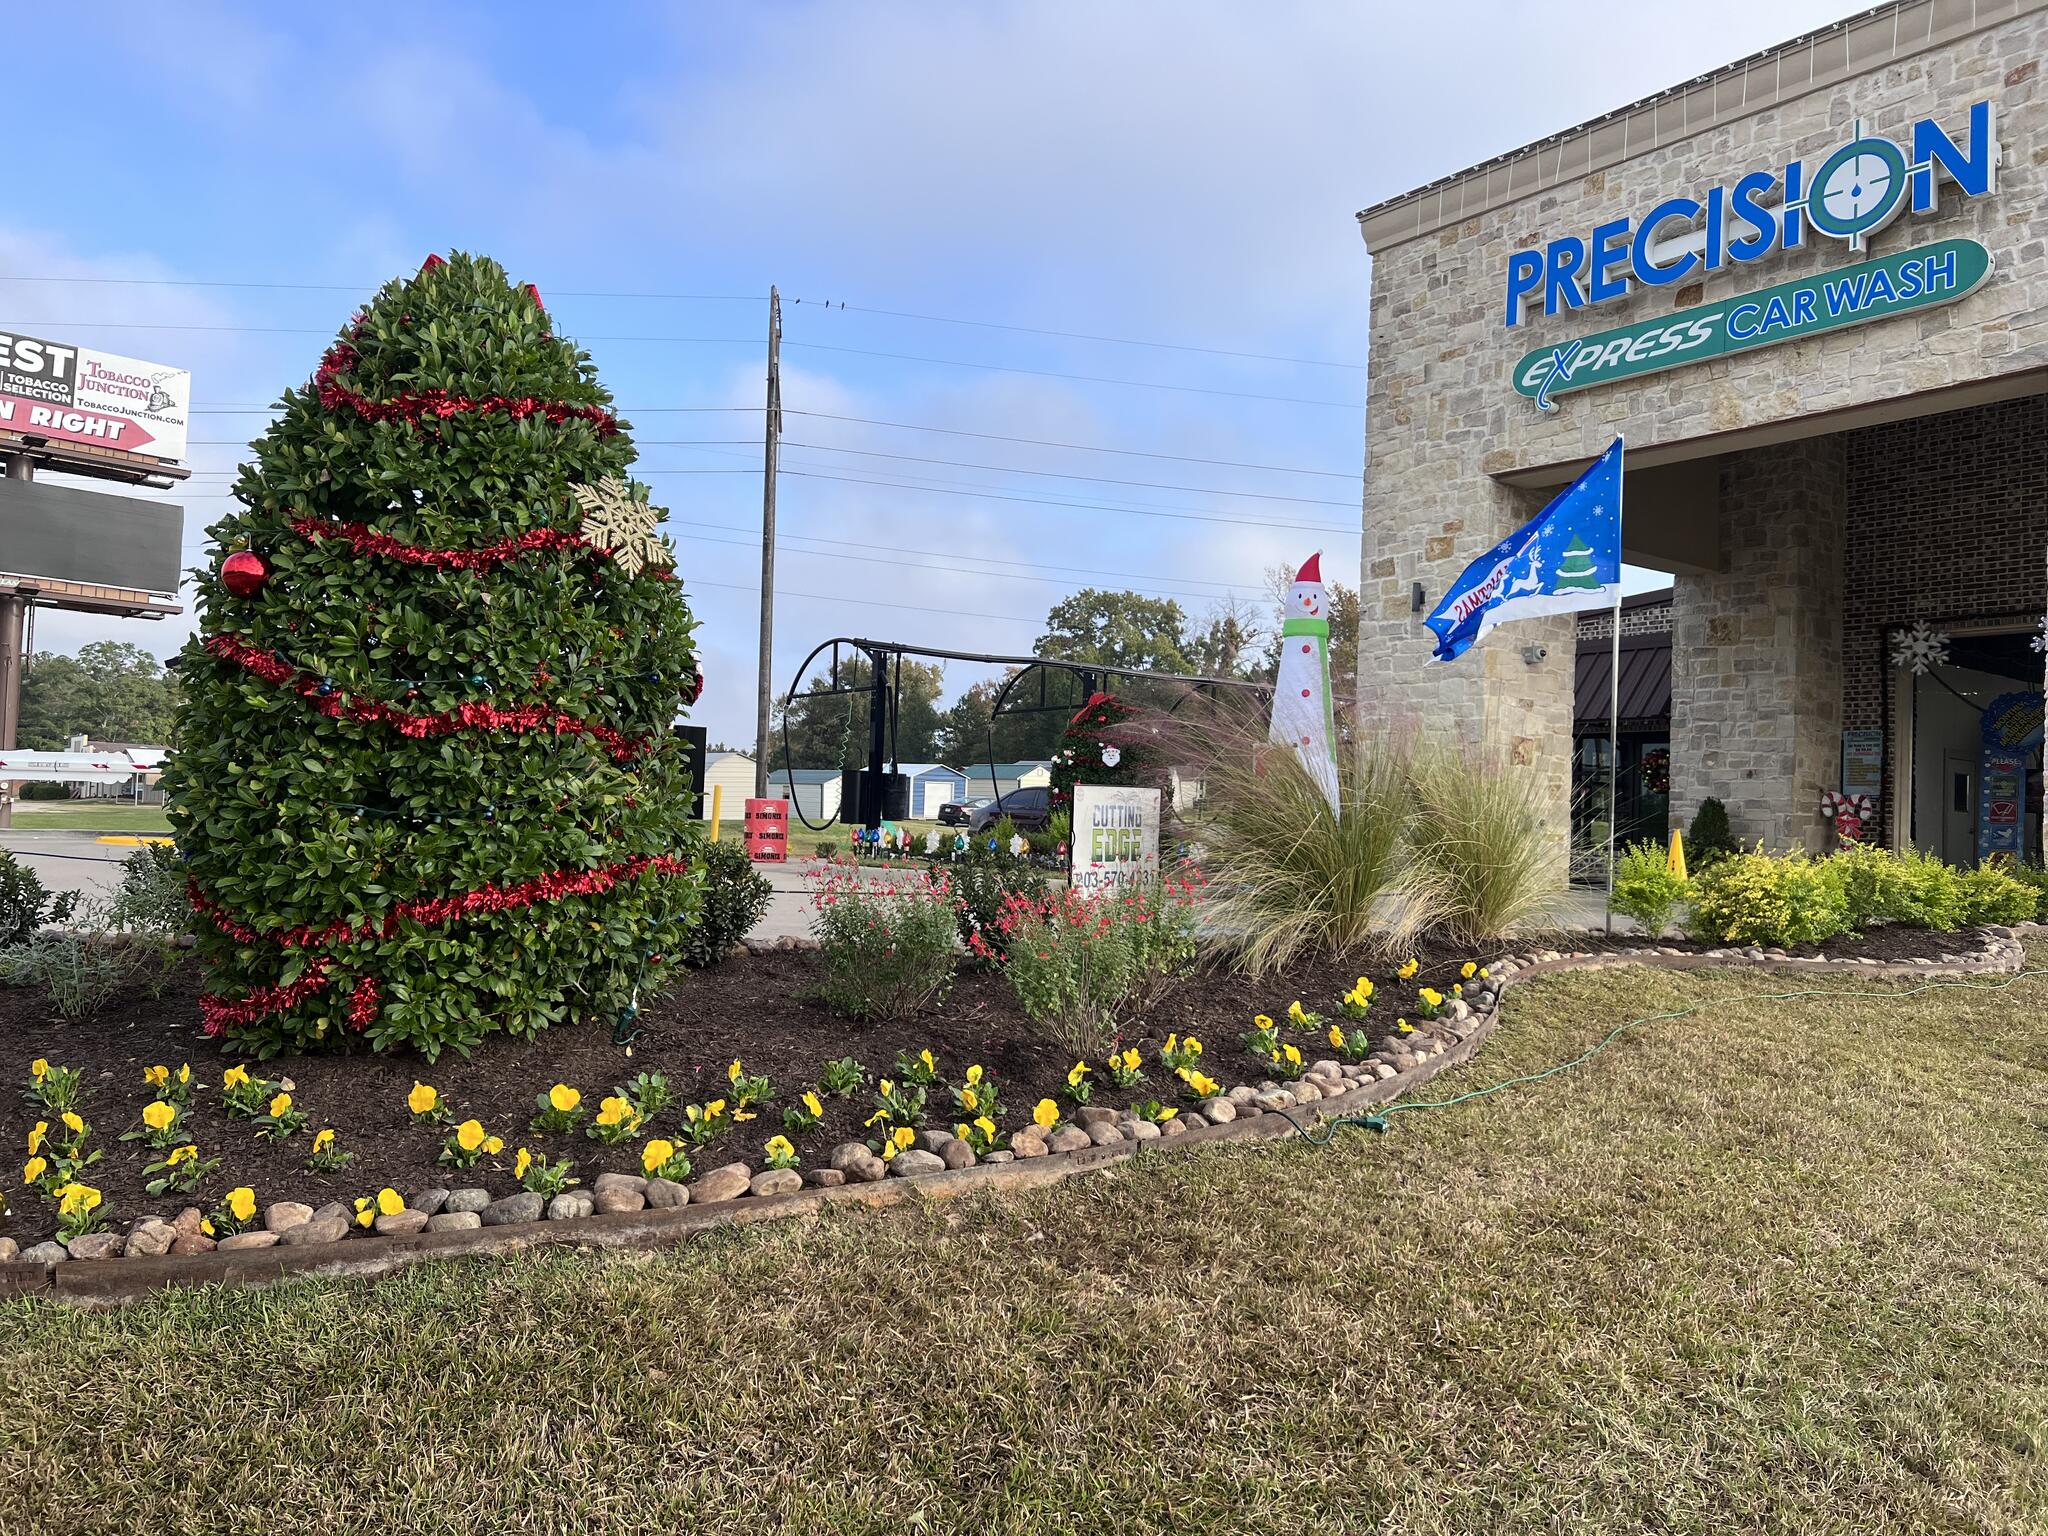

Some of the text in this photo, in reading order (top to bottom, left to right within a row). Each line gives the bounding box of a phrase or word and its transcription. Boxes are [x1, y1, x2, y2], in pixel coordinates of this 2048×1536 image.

[1505, 99, 1997, 327] PRECISION
[1522, 250, 1958, 412] EXPRESS CAR WASH
[3, 382, 72, 404] SELECTION
[8, 373, 69, 393] TOBACCO
[29, 405, 126, 441] RIGHT
[1093, 804, 1142, 827] CUTTING
[1091, 828, 1142, 862] EDGE
